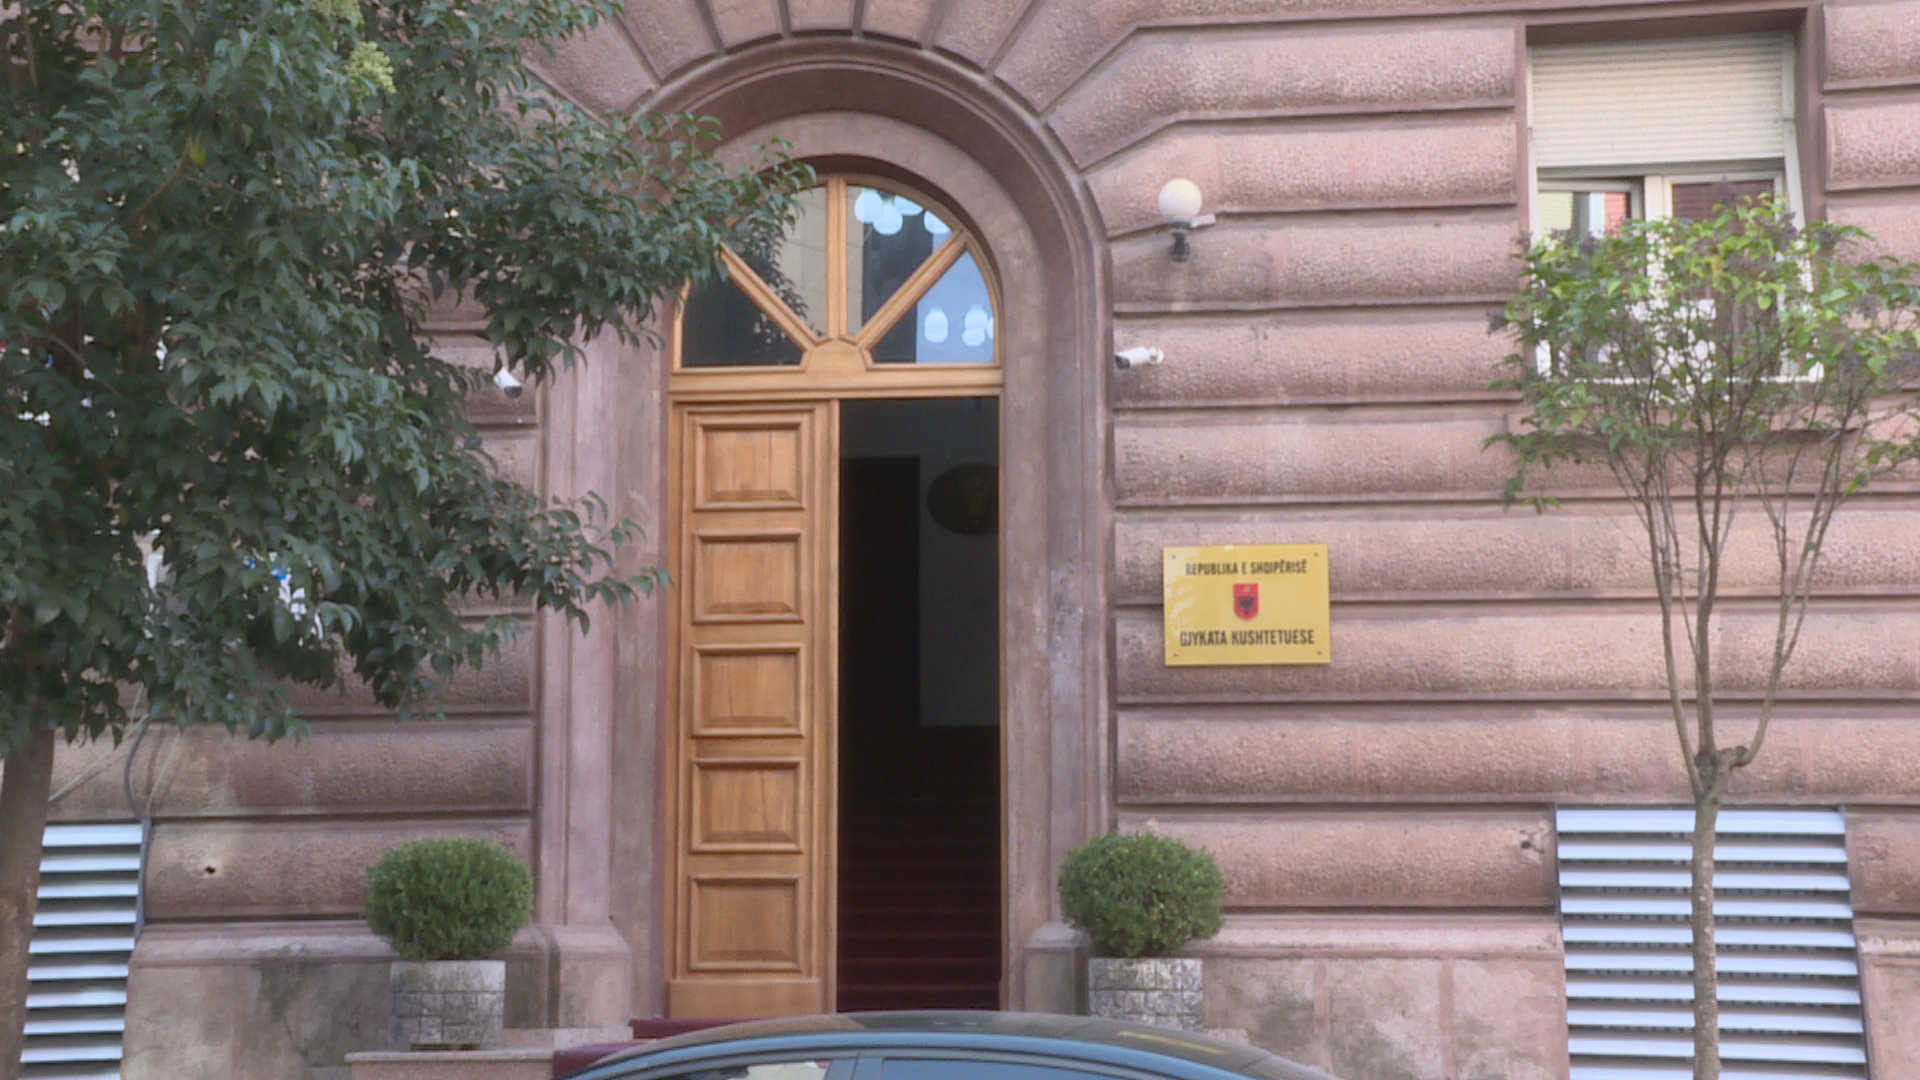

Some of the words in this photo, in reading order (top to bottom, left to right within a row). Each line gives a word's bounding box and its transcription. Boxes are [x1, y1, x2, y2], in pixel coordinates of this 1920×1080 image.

[1185, 561, 1239, 575] REPUBLIKA
[1241, 562, 1248, 575] E
[1180, 631, 1228, 647] GJYKATA
[1231, 629, 1315, 646] KUSHTETUESE
